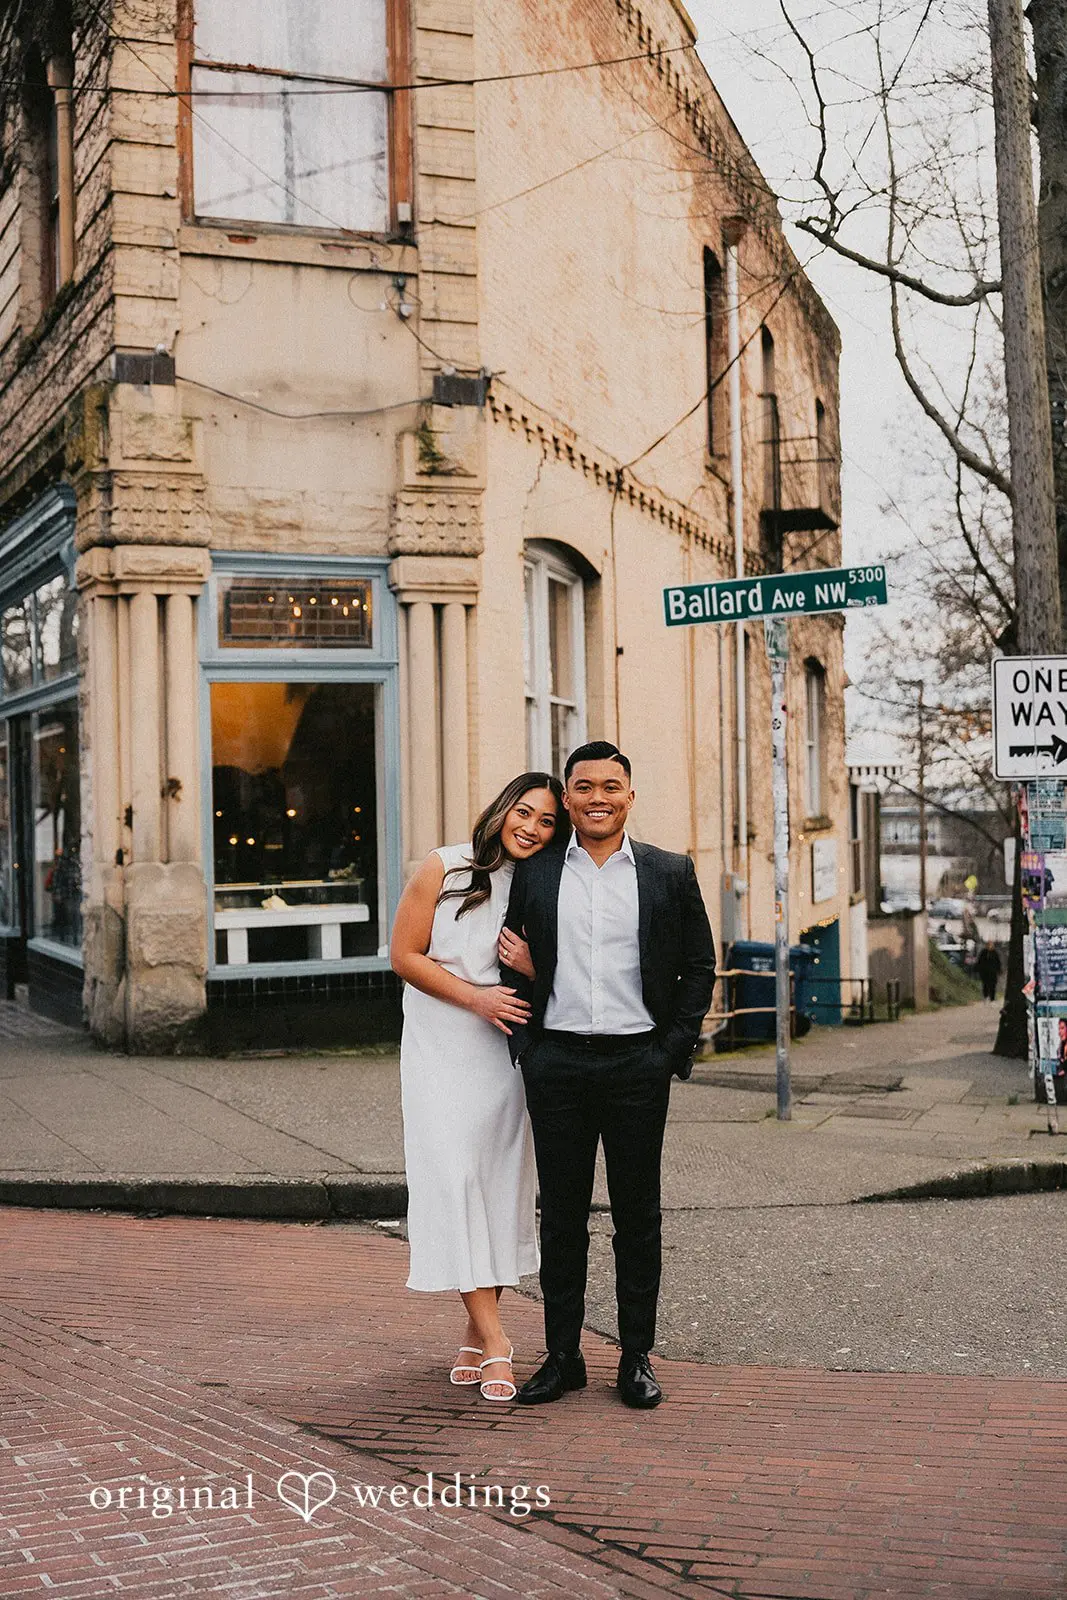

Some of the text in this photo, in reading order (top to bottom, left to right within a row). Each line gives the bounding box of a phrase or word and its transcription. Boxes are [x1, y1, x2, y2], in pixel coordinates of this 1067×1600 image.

[848, 567, 884, 584] 5300
[668, 582, 846, 620] Ballard Ave NW
[1012, 669, 1067, 693] ONE
